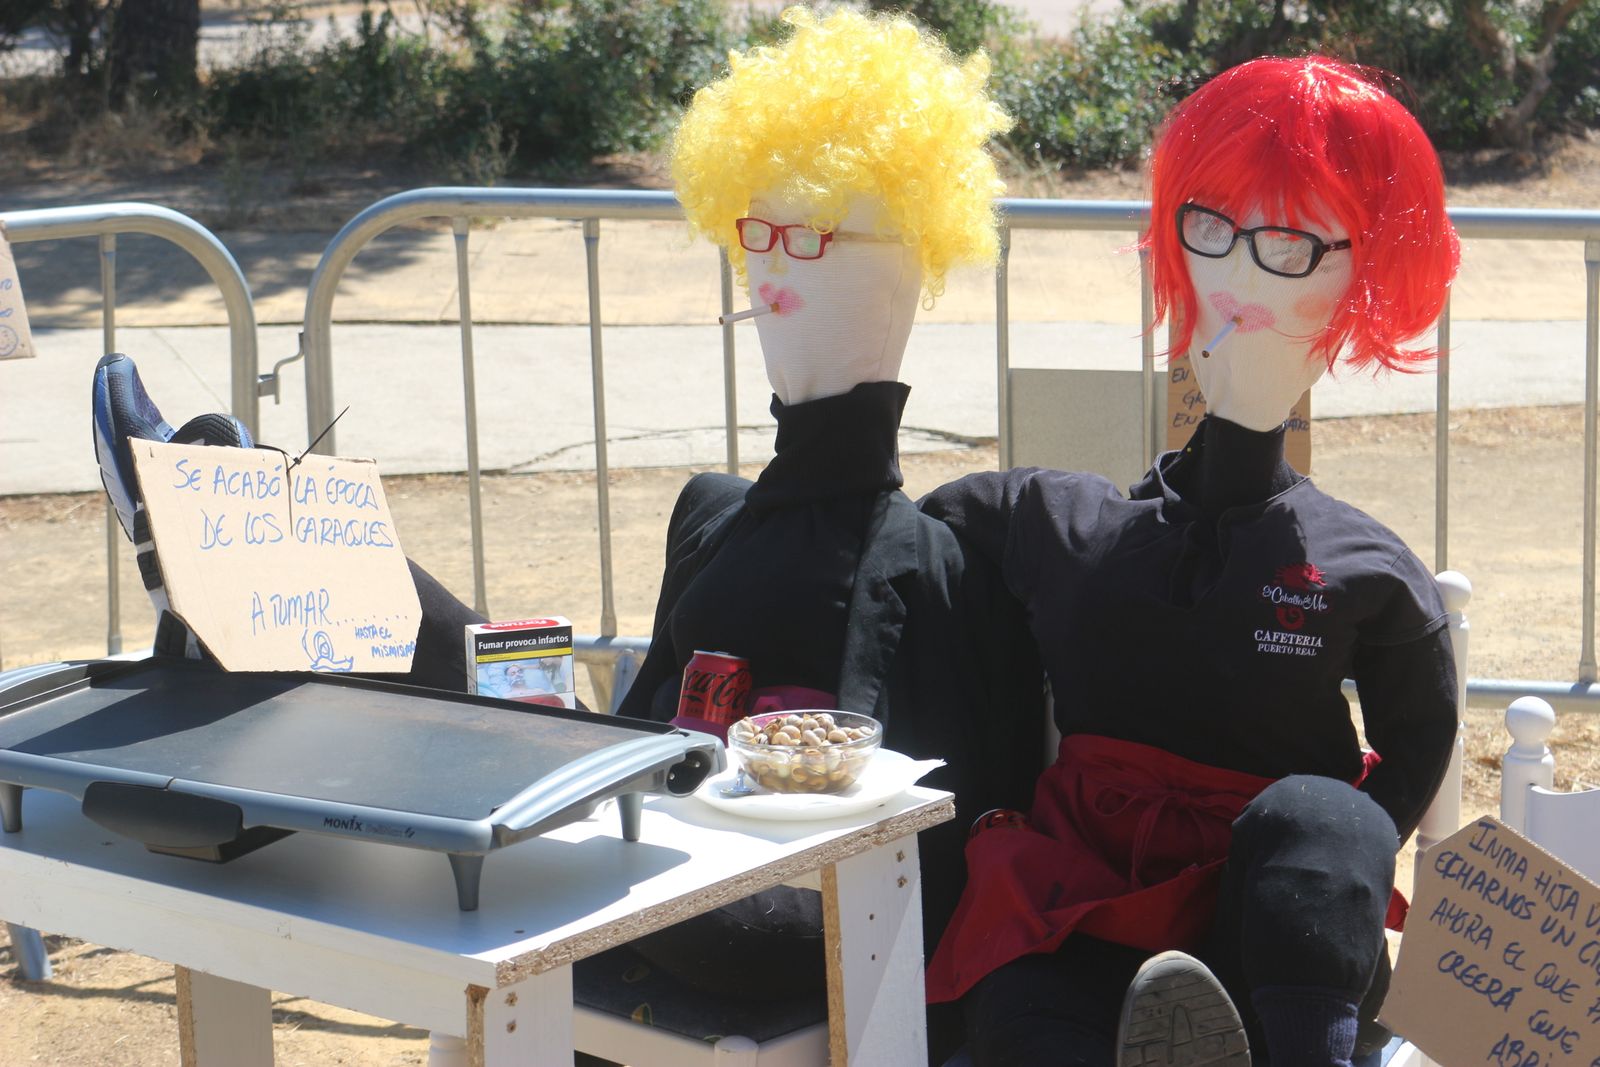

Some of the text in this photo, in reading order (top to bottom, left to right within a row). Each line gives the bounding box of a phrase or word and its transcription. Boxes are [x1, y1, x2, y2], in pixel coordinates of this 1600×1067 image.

[173, 458, 379, 511] SE ACABÓ LA ÉPOCA
[199, 508, 394, 550] DE LOS CARACOLES
[252, 591, 266, 636] A
[478, 635, 569, 650] Fumar provoca infartos
[1254, 629, 1323, 648] CAFETERIA
[1257, 643, 1317, 656] PUERTO REAL
[1469, 821, 1529, 882] INMA
[1534, 869, 1581, 921] HIJA
[1434, 851, 1537, 920] ECHARNOS
[1540, 915, 1577, 947] UN
[1429, 897, 1581, 1003] AHORA EL QUE
